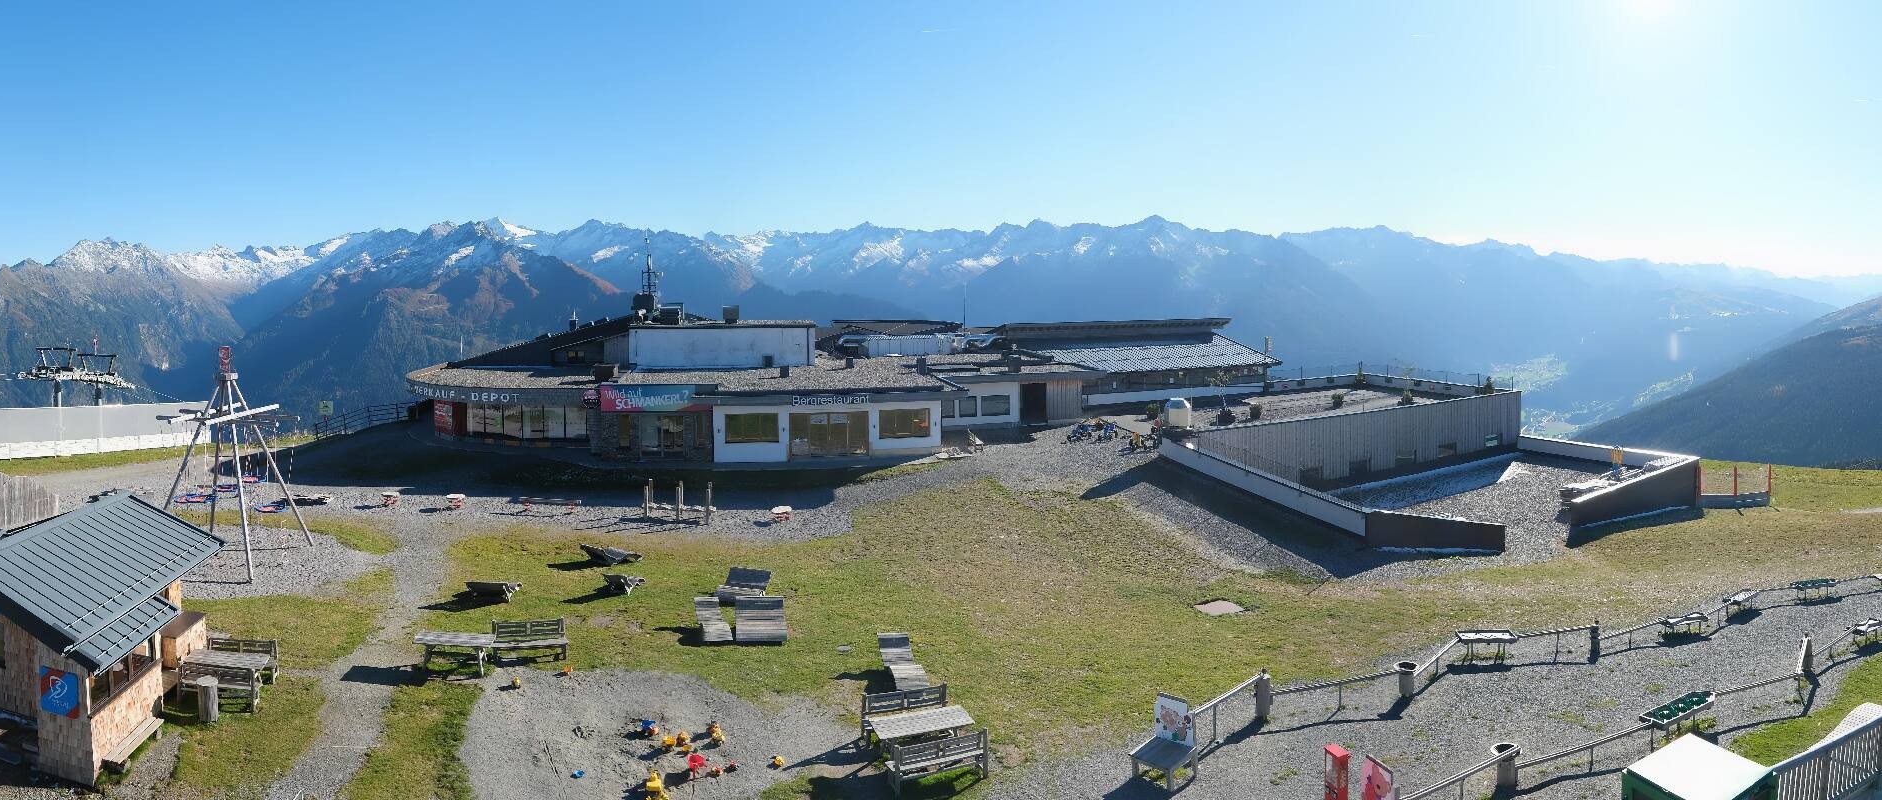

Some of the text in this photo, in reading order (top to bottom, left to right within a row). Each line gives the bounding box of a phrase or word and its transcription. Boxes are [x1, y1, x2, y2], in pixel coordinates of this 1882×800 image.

[471, 392, 520, 403] DEPOT
[604, 388, 625, 399] Wild
[627, 387, 642, 397] auf
[615, 390, 689, 410] SCHMANKERL?
[792, 395, 870, 406] Bergrestaurant
